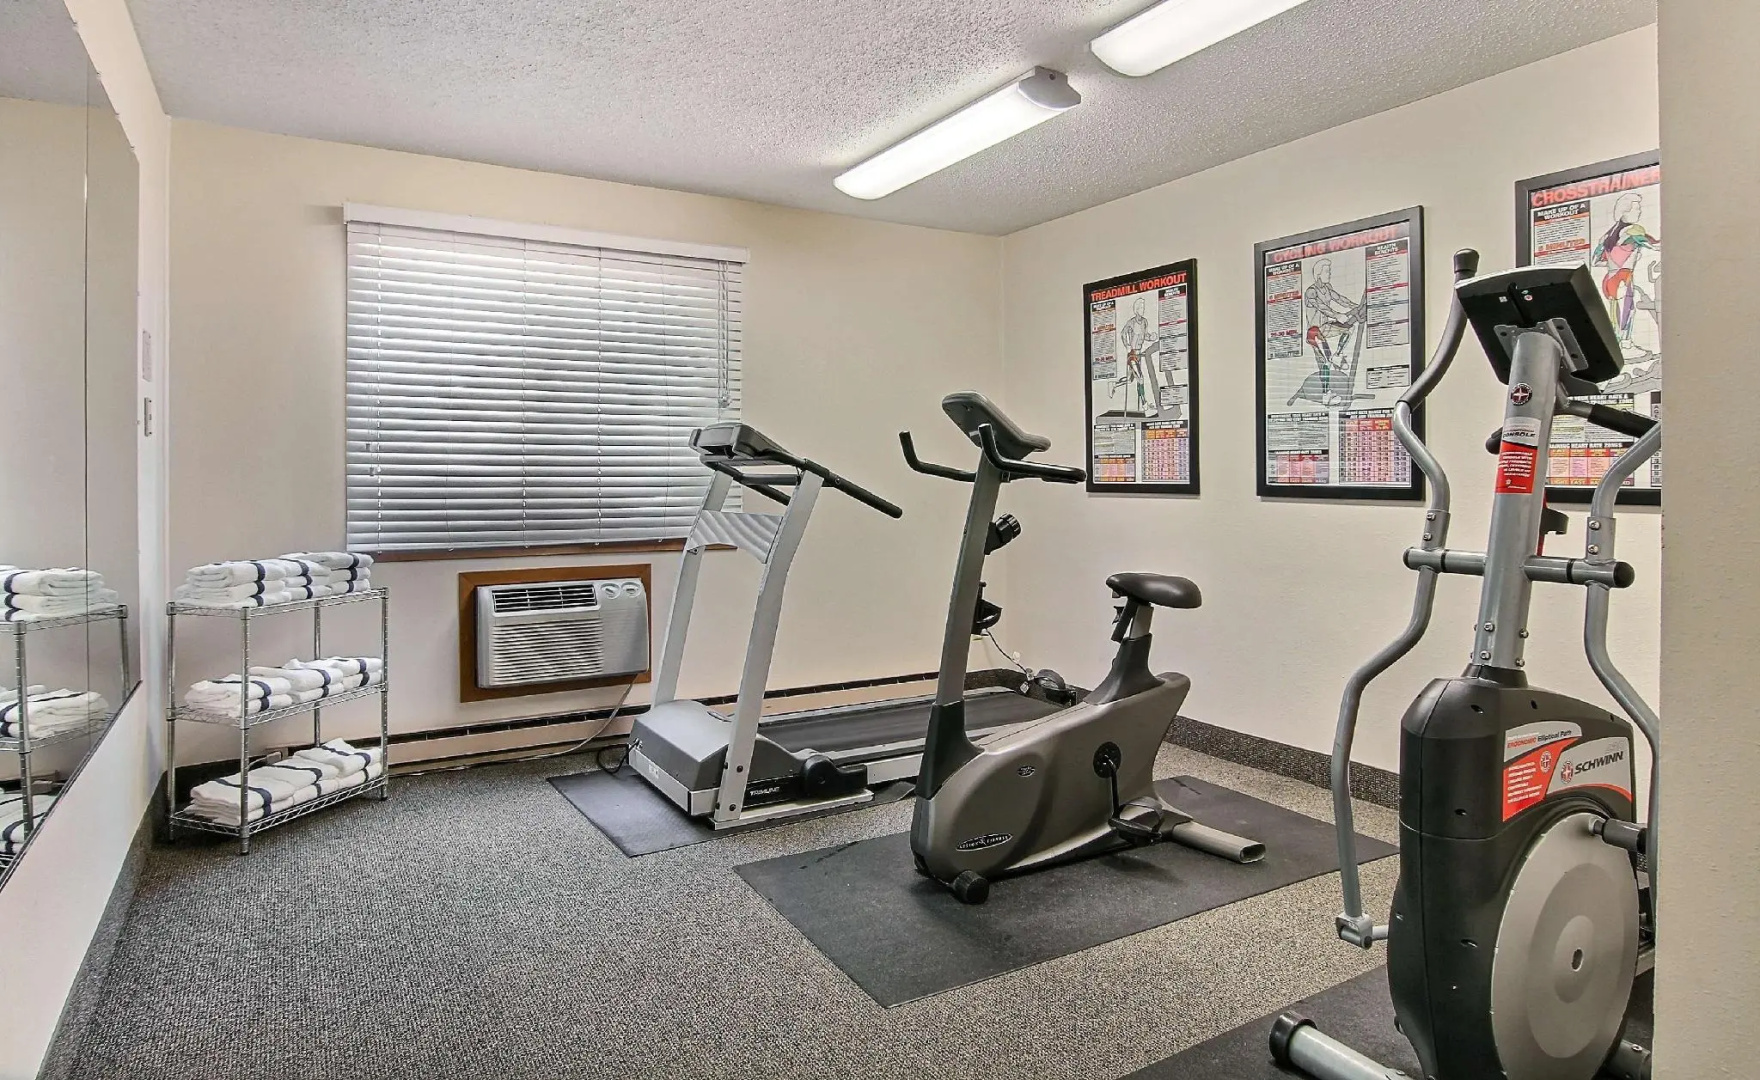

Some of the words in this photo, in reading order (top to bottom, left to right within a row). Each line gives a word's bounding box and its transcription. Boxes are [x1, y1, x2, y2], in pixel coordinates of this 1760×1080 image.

[1538, 209, 1556, 217] MAKE
[1544, 208, 1579, 220] WORKOUT
[1272, 243, 1327, 263] CYCLING
[1328, 229, 1398, 251] WORKOUT
[1374, 247, 1399, 256] BENEFITS
[1090, 284, 1138, 302] TREADMILL
[1140, 272, 1187, 292] WORKOUT
[1538, 732, 1559, 742] Elliptical
[1574, 750, 1624, 774] SCHWINN
